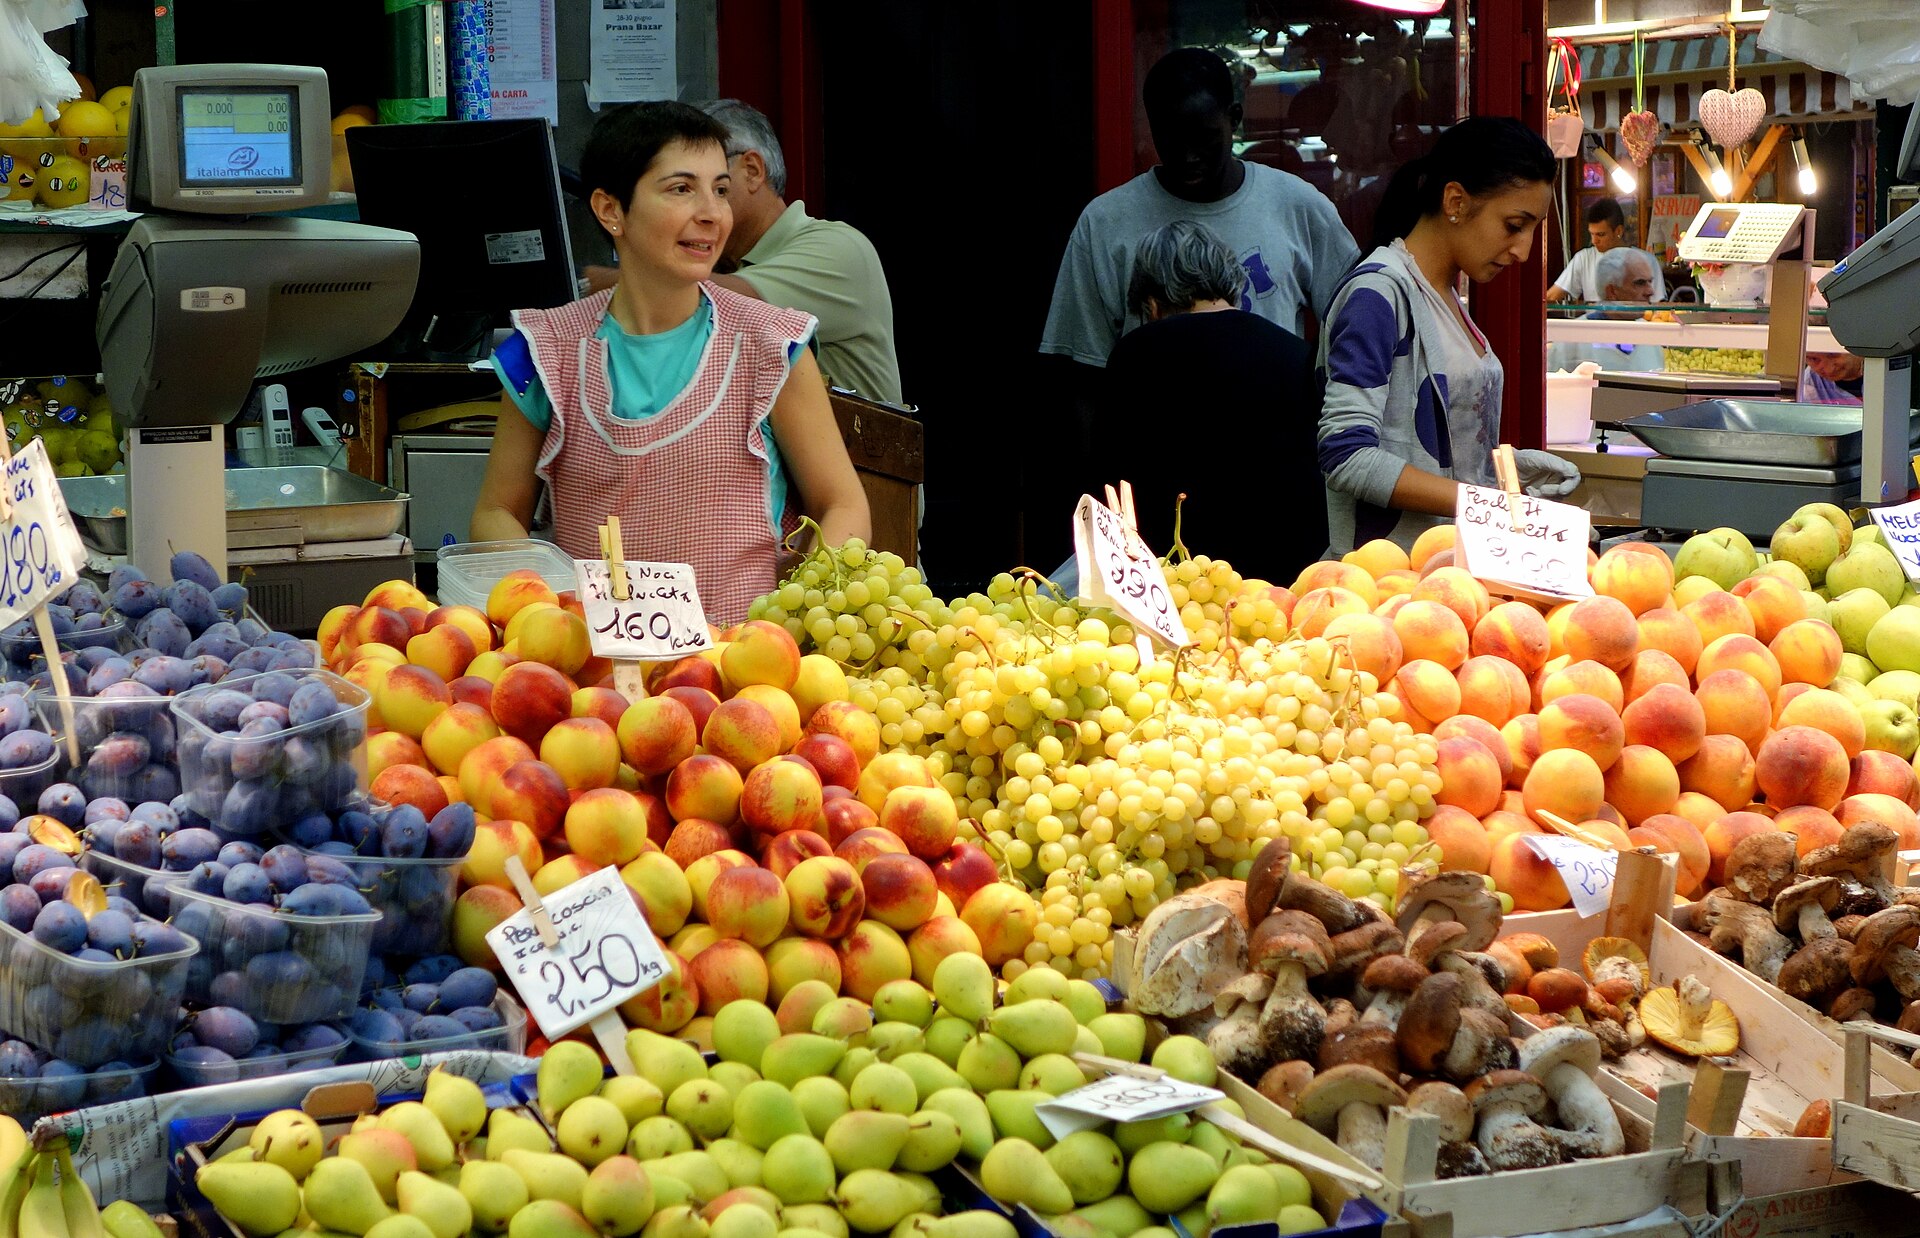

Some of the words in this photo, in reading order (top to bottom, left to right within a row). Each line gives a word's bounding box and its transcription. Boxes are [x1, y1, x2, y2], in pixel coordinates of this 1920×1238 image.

[502, 90, 528, 98] CARTA
[206, 102, 233, 113] 0.000
[267, 102, 288, 113] 0.00
[267, 121, 288, 132] 0.00
[197, 166, 240, 177] italiana
[244, 166, 284, 176] macchi
